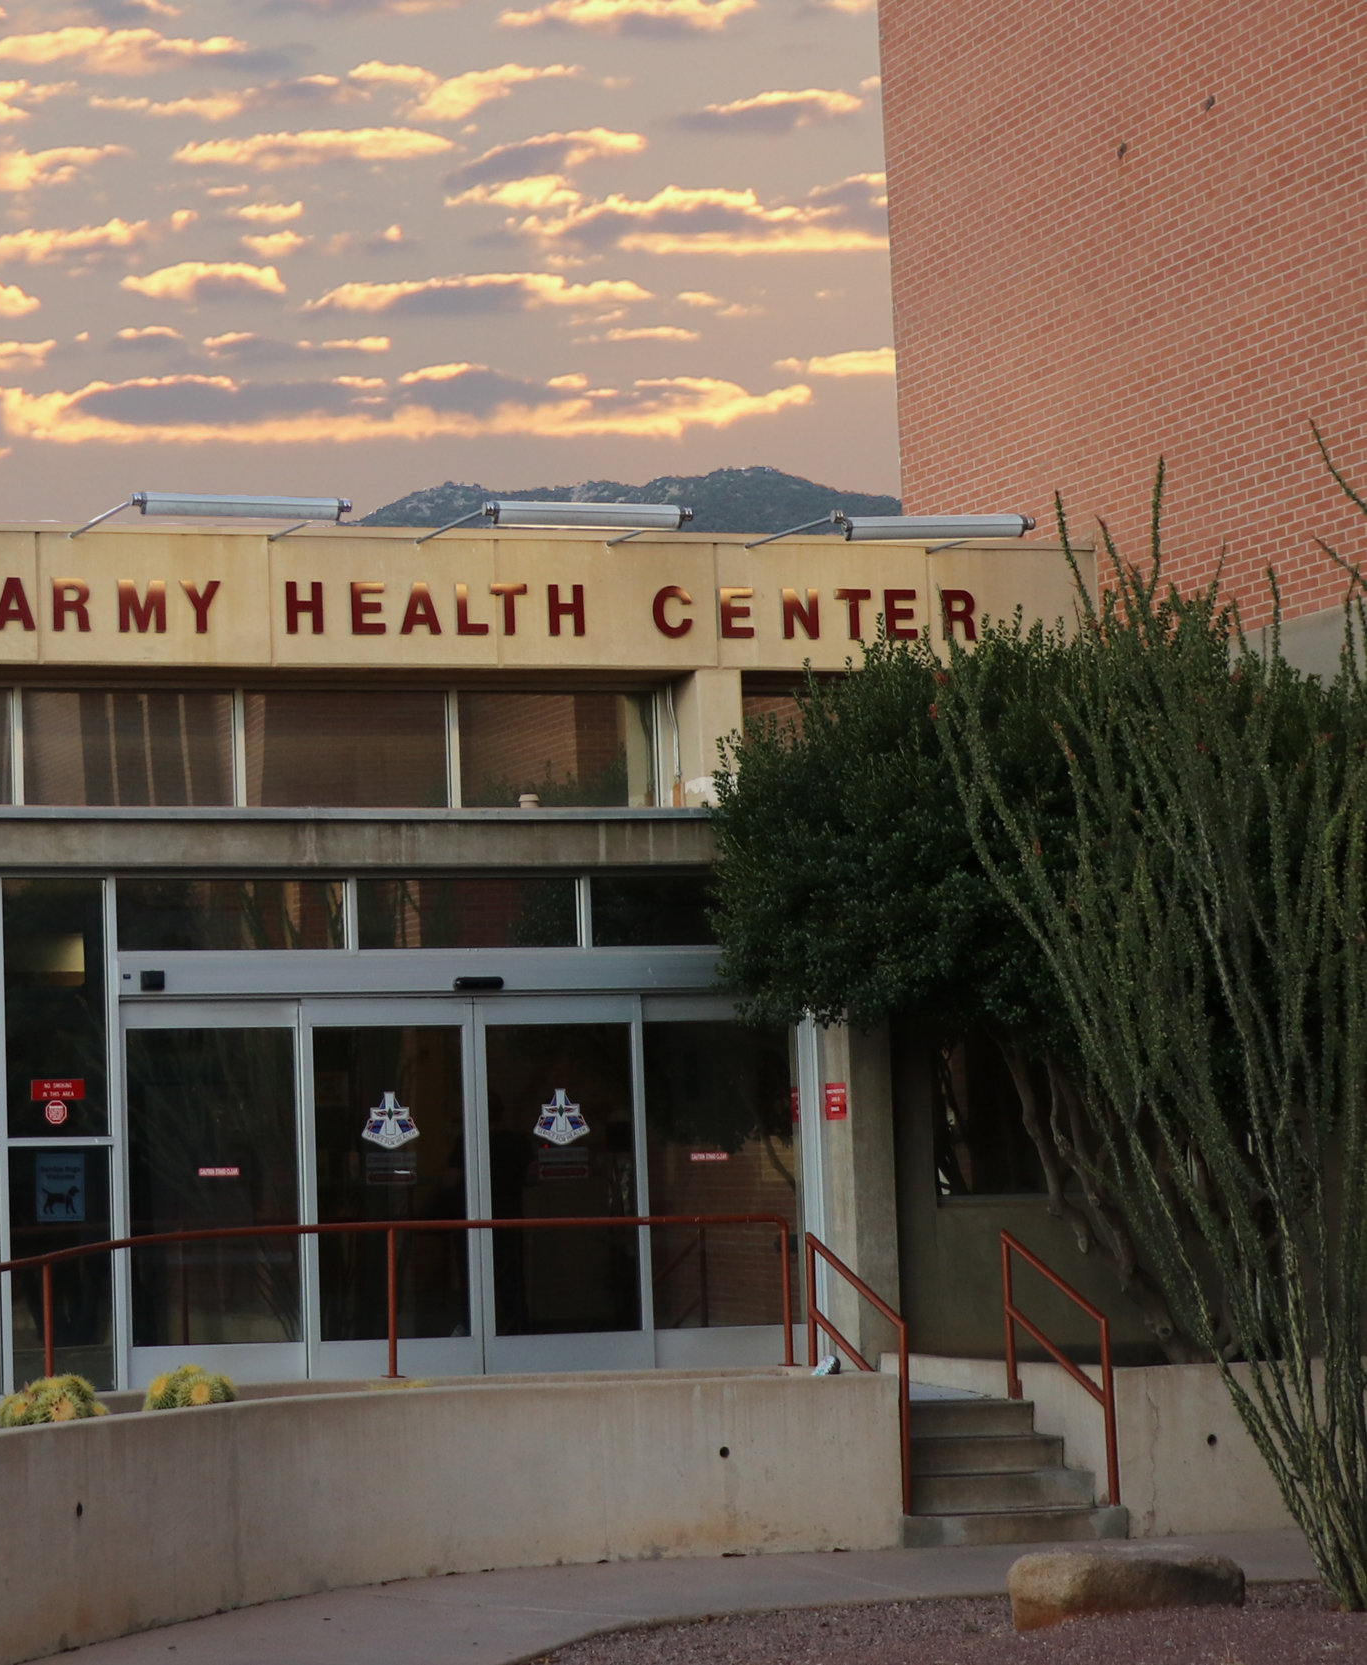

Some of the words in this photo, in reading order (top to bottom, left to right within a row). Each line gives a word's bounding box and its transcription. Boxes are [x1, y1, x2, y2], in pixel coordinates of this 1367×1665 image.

[285, 581, 586, 636] HEALTH
[652, 585, 977, 641] CENTER
[366, 1131, 383, 1143] SERVICE
[384, 1138, 395, 1146] FOR
[396, 1131, 417, 1144] HEALTH
[537, 1127, 555, 1139] SERVICE
[555, 1134, 566, 1142] FOR
[567, 1127, 587, 1140] HEALTH
